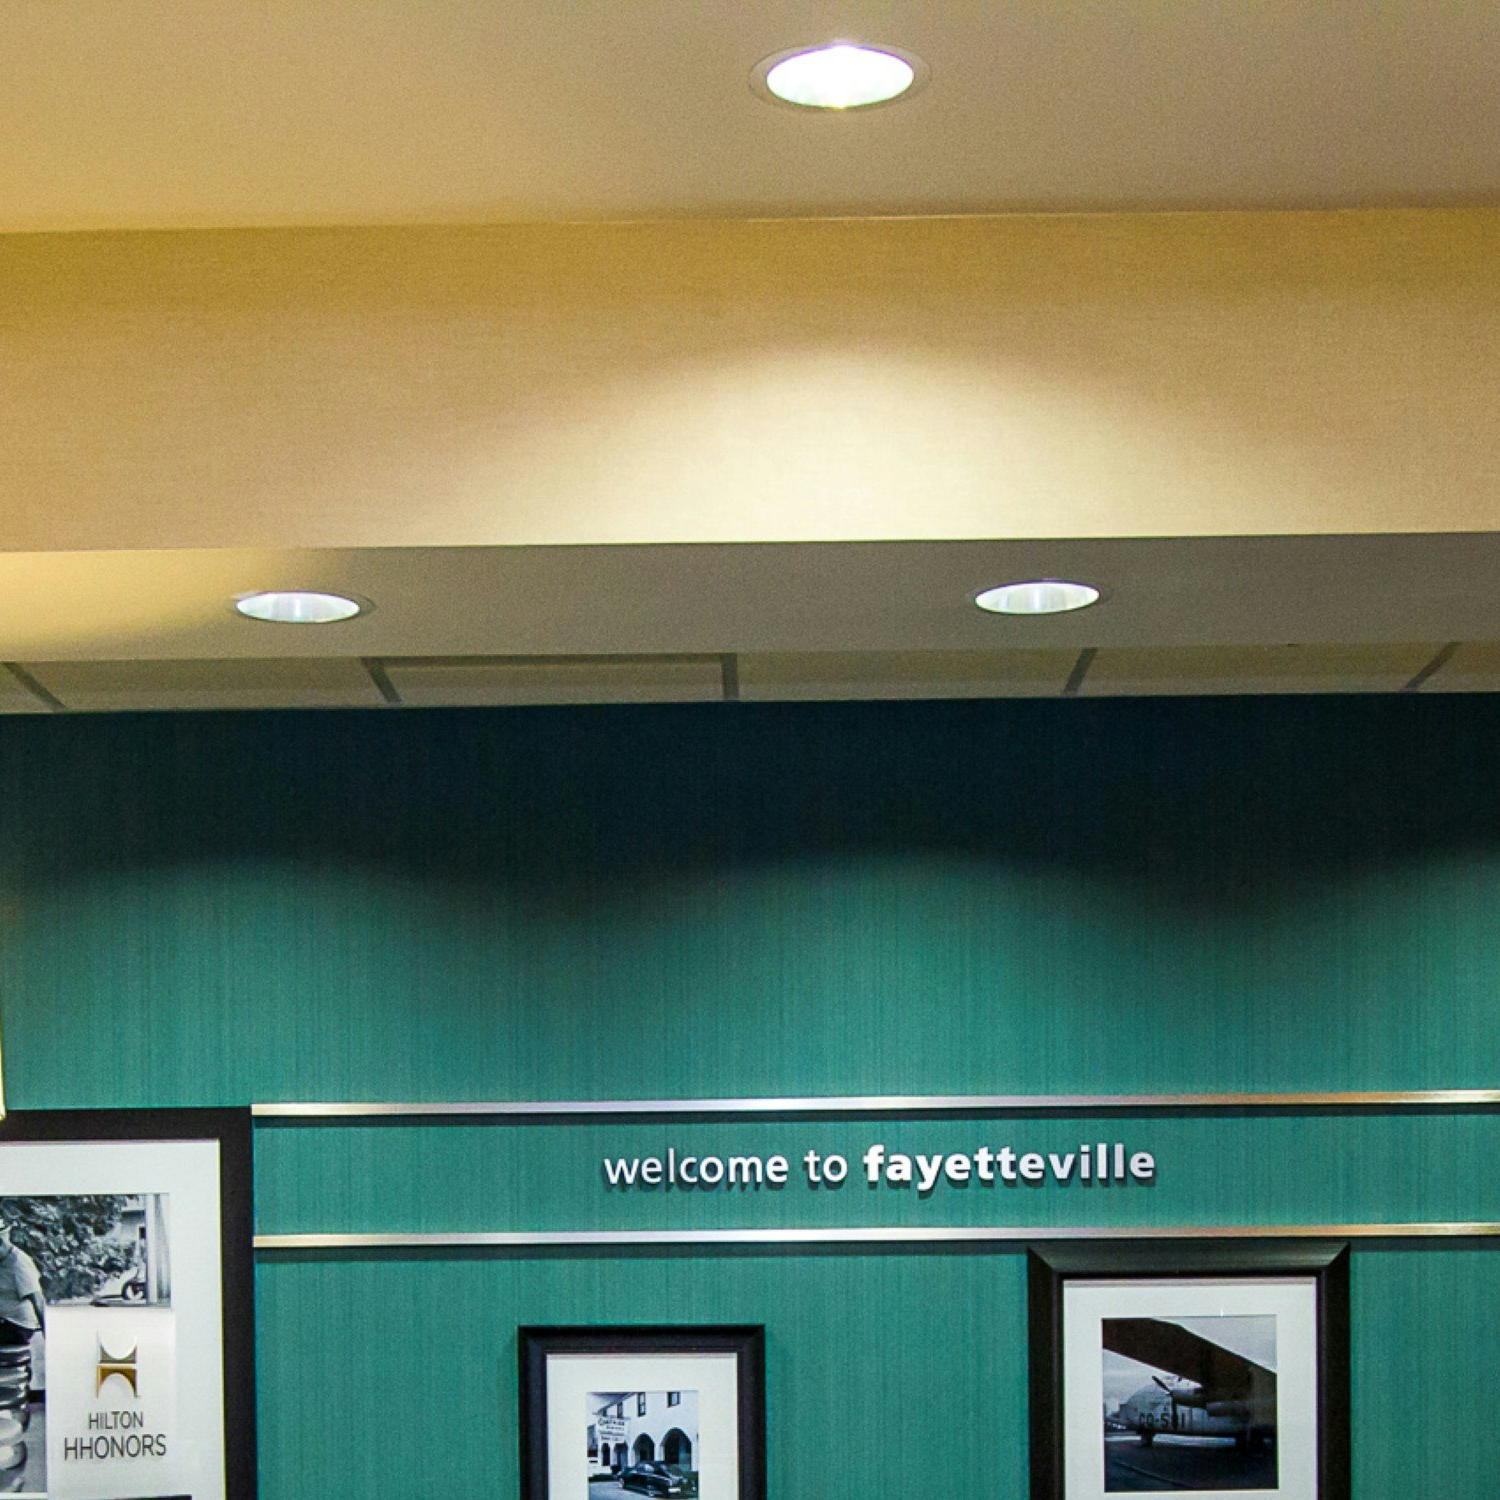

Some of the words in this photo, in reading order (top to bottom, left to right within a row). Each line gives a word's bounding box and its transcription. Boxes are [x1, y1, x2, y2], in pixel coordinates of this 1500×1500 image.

[604, 1148, 789, 1185] welcome
[803, 1150, 848, 1183] to
[863, 1143, 1156, 1191] fayetteville
[88, 1411, 144, 1430] HILTON
[64, 1434, 167, 1460] HHONORS
